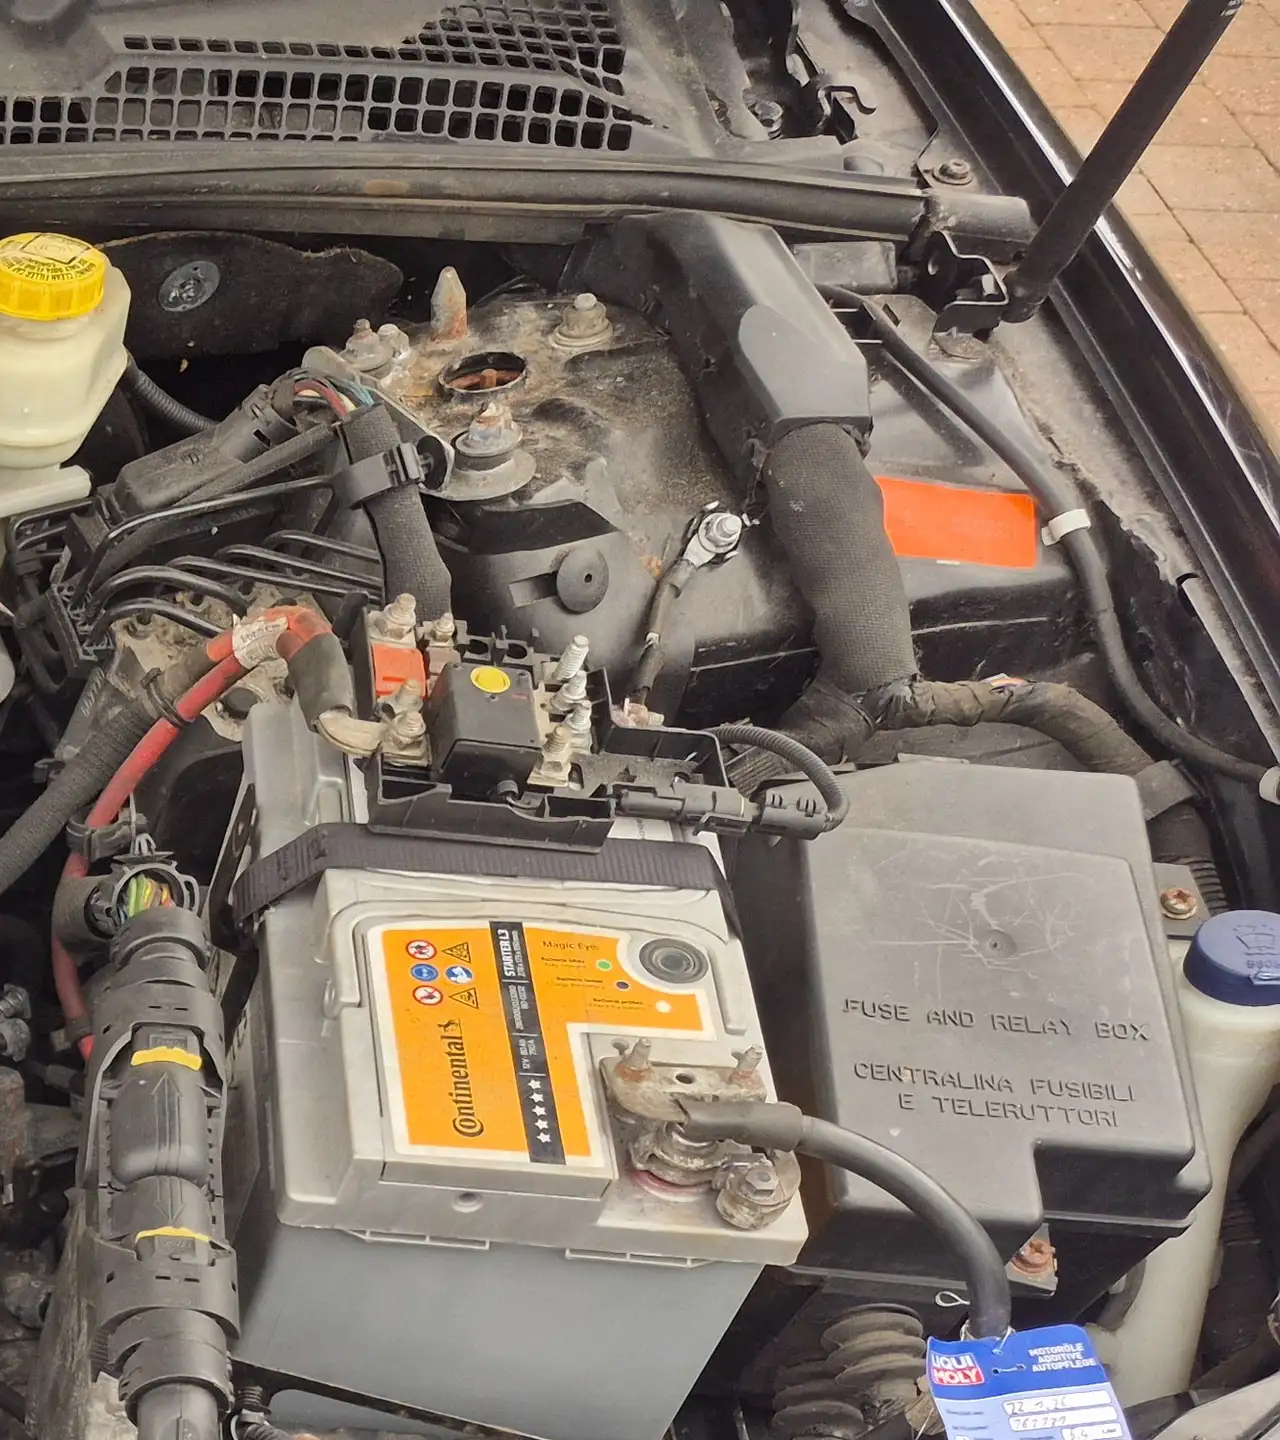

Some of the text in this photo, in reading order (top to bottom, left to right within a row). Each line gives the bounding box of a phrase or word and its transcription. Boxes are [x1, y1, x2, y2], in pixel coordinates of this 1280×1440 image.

[542, 940, 574, 951] Magic
[499, 939, 516, 977] STARTER
[842, 998, 1151, 1041] FUSE AND RELAY BOX
[440, 1035, 485, 1137] Continental
[854, 1062, 1137, 1103] CENTRALINA FUSIBILI
[898, 1092, 1119, 1128] E TELERUTTORI
[1028, 1342, 1085, 1357] MOTORÖLE
[1038, 1352, 1083, 1364] ADDITIVE
[931, 1353, 973, 1370] LIQUI
[1032, 1358, 1097, 1373] AUTOPFLEGE
[933, 1368, 978, 1384] MOLY
